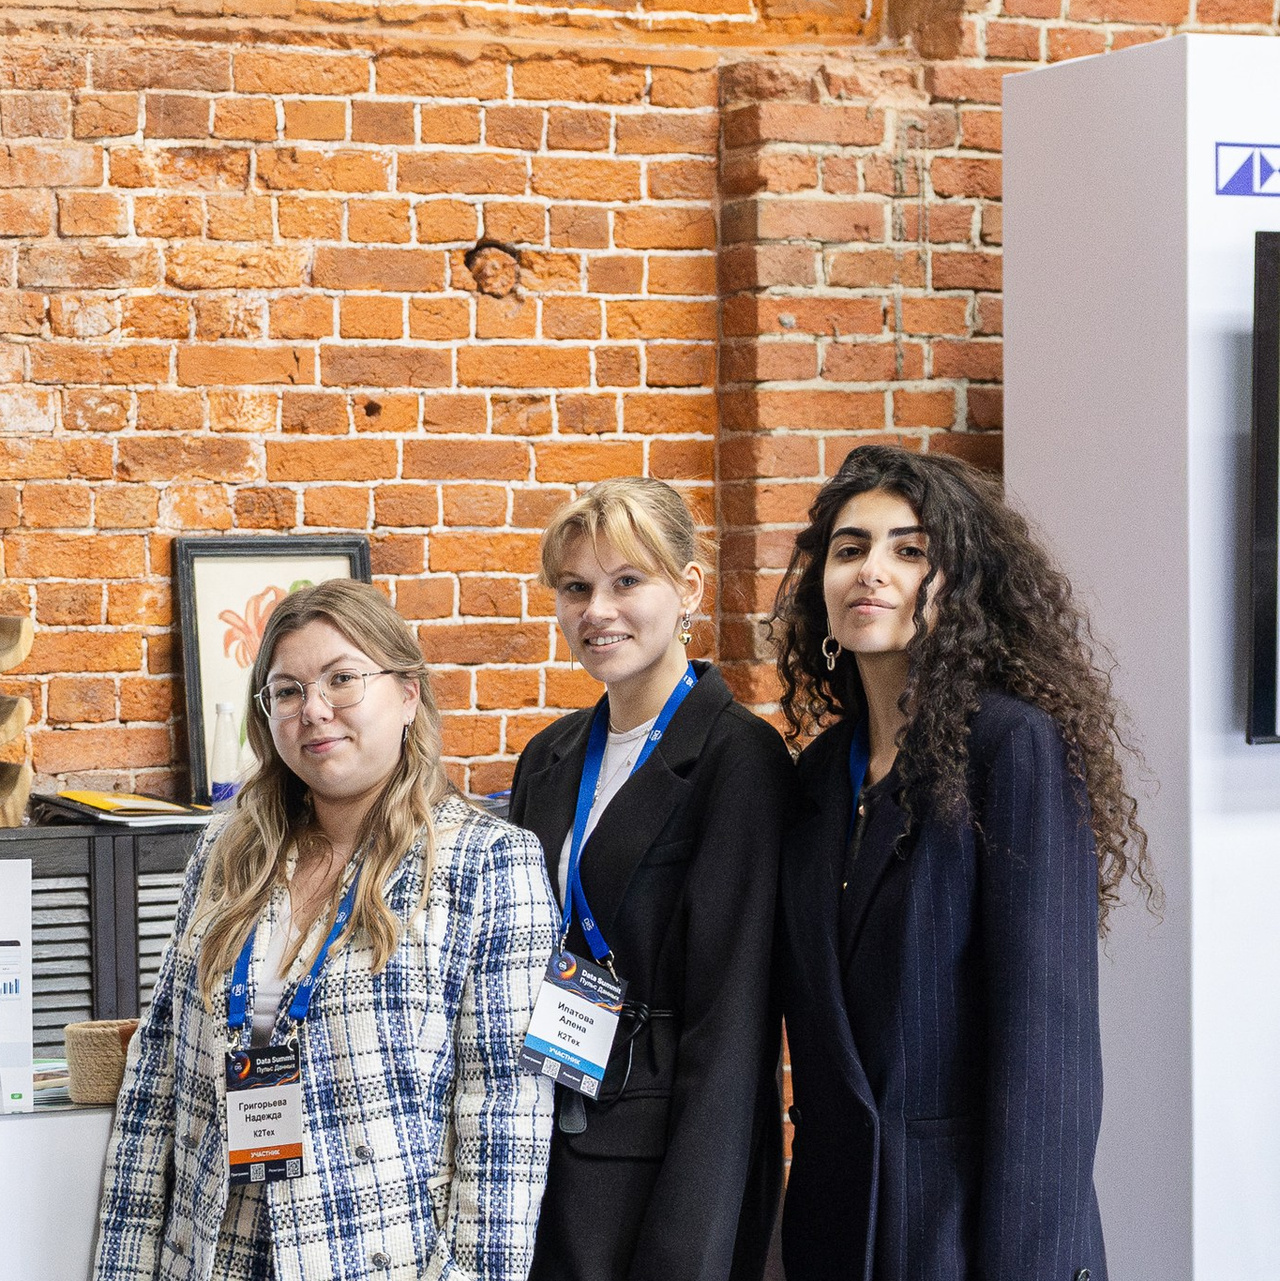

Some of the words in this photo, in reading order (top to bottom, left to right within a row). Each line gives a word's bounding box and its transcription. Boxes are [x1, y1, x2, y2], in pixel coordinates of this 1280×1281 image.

[581, 969, 597, 983] Data
[598, 977, 622, 994] Summit
[557, 1001, 595, 1026] Ипатова
[558, 1015, 587, 1034] Алена
[255, 1057, 271, 1066] Data
[271, 1054, 296, 1064] Summit
[548, 1046, 581, 1066] УЧАСТНИК
[238, 1098, 288, 1113] Григорьева
[245, 1111, 282, 1123] Надежда
[250, 1149, 281, 1159] УЧАСТНИК
